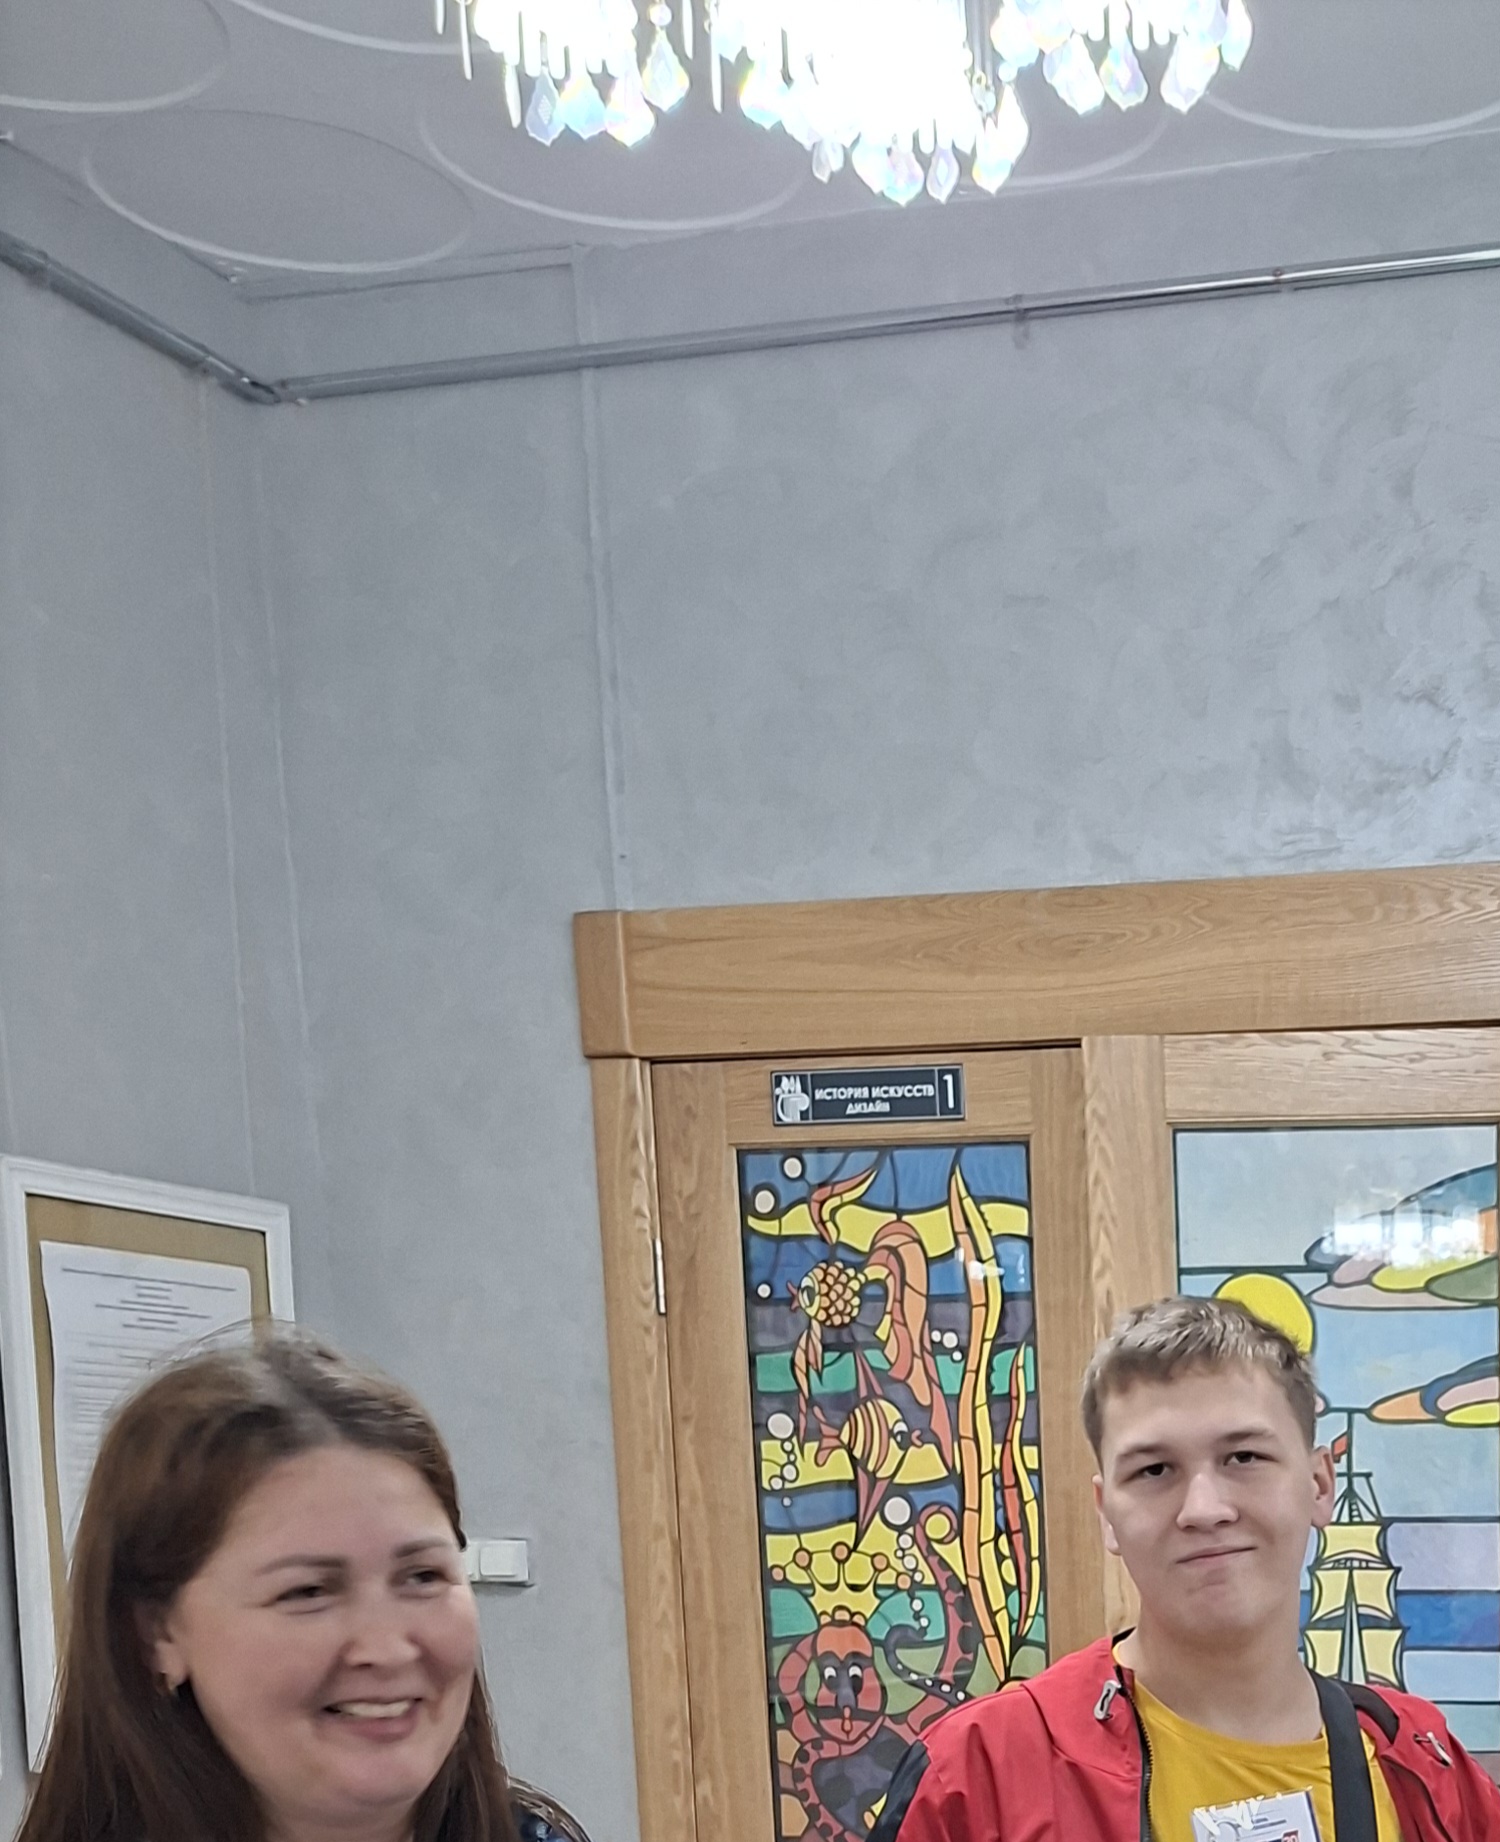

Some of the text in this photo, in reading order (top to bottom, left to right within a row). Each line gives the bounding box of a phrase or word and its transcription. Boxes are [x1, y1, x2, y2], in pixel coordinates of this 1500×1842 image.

[814, 1084, 935, 1101] ИСТОРИЯ ИСКУССТВ
[942, 1074, 955, 1109] 1
[845, 1100, 891, 1115] ДИЗАЙН
